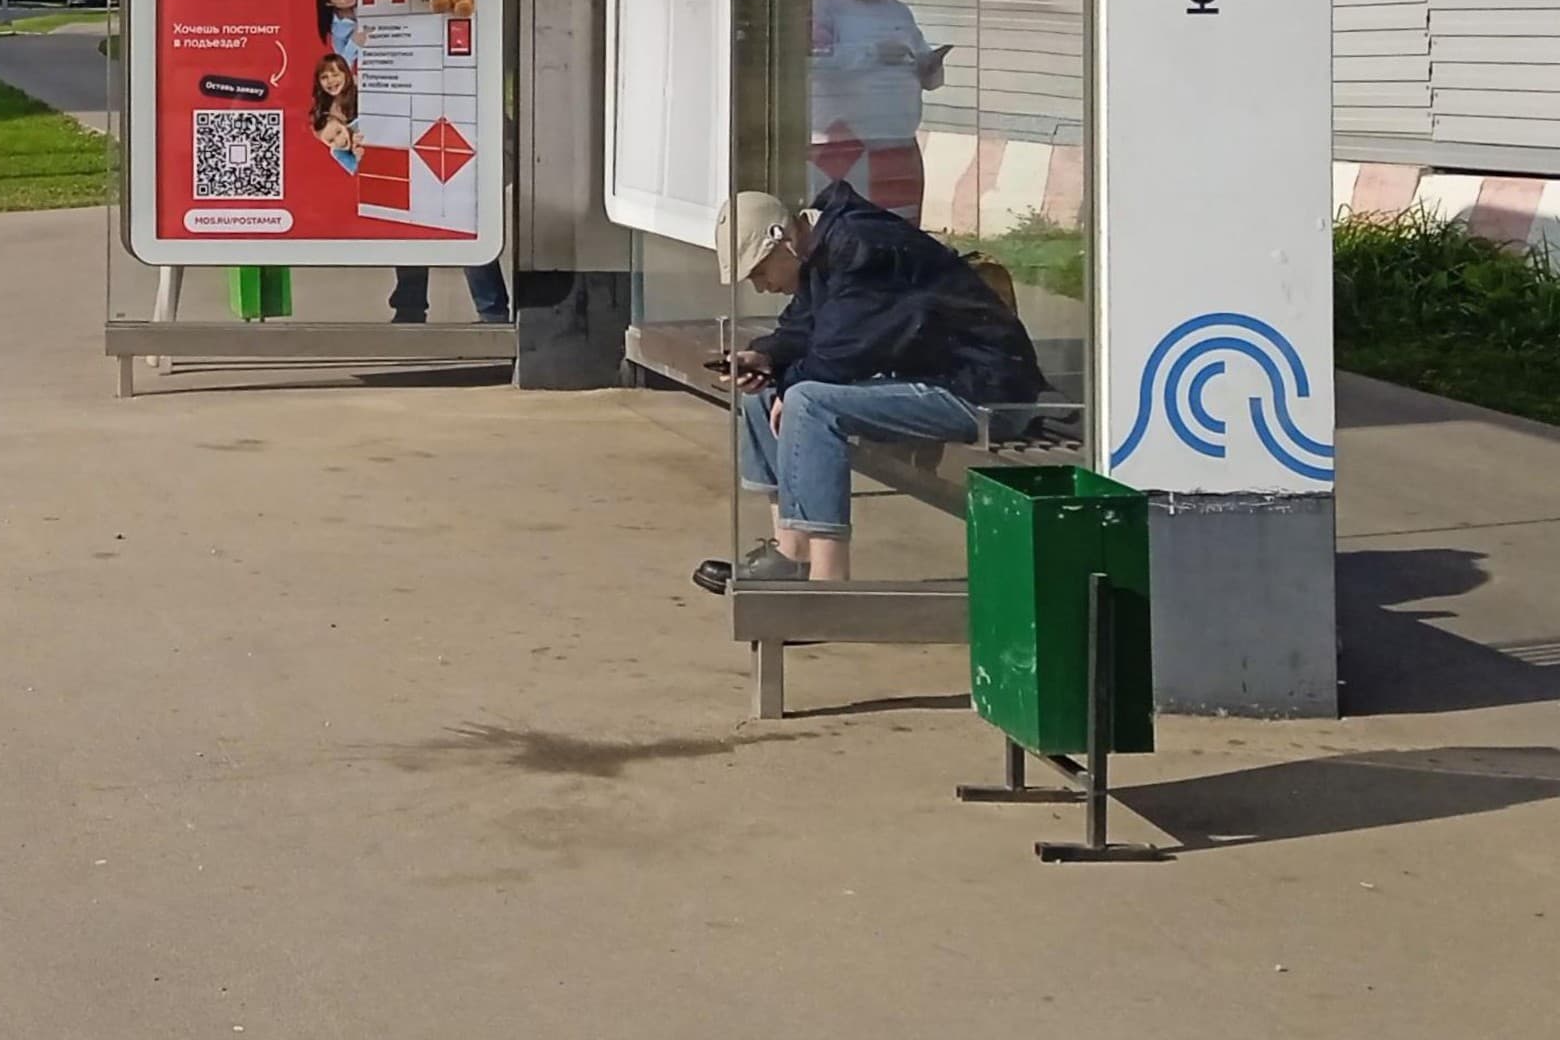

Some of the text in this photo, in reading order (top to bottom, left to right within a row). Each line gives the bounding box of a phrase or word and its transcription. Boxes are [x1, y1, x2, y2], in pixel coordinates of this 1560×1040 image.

[172, 23, 281, 35] Хочешь постамат
[173, 36, 248, 49] в подъезде?
[195, 216, 282, 225] MOS.RU/POSTAMAT
